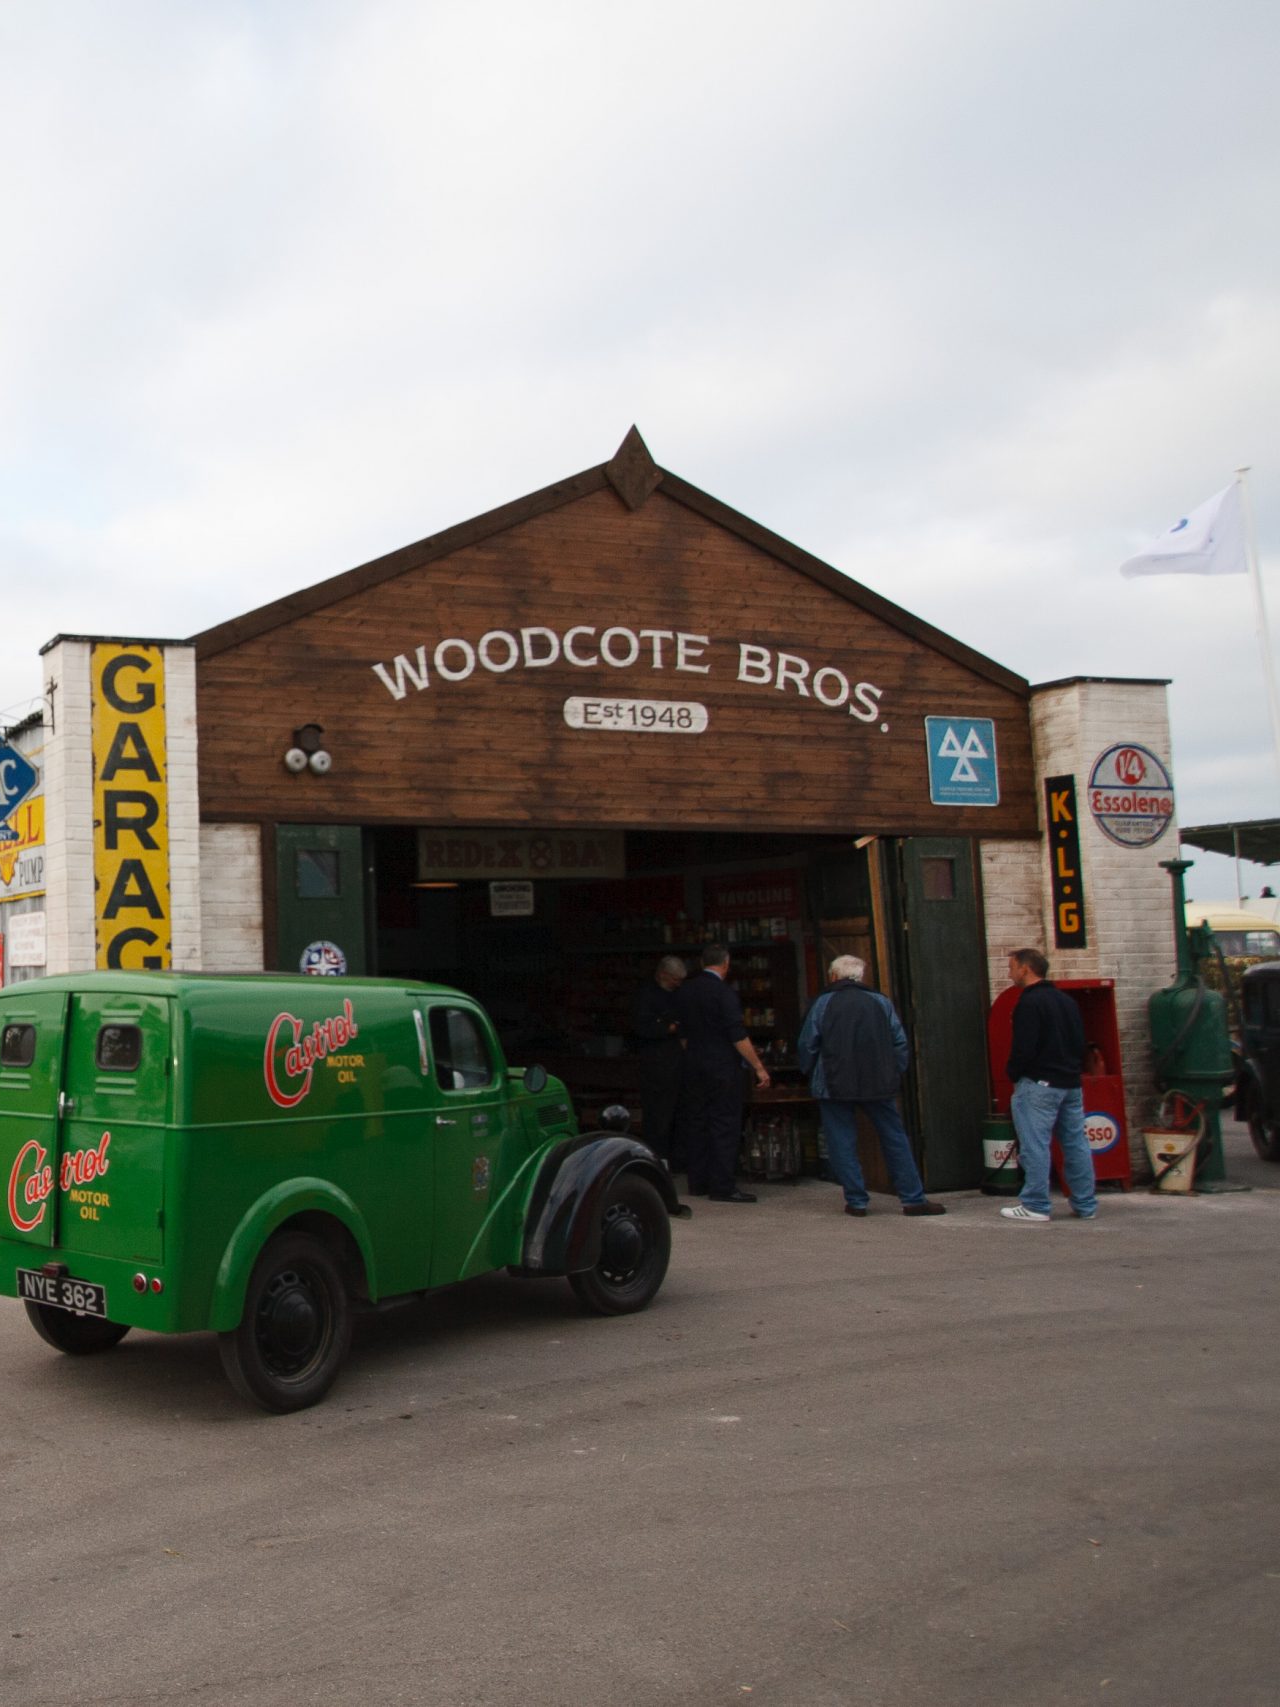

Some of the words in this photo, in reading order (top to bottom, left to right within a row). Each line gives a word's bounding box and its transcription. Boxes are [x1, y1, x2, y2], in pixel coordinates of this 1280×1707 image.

[371, 626, 711, 700] WOODCOTE
[736, 643, 889, 733] BROS.
[264, 997, 359, 1108] Castrol
[326, 1054, 366, 1068] MOTOR
[337, 1070, 357, 1083] OIL
[7, 1131, 111, 1232] Castrol
[70, 1188, 111, 1207] MOTOR
[79, 1206, 100, 1221] OIL
[23, 1273, 58, 1302] NYE
[61, 1284, 98, 1312] 362
